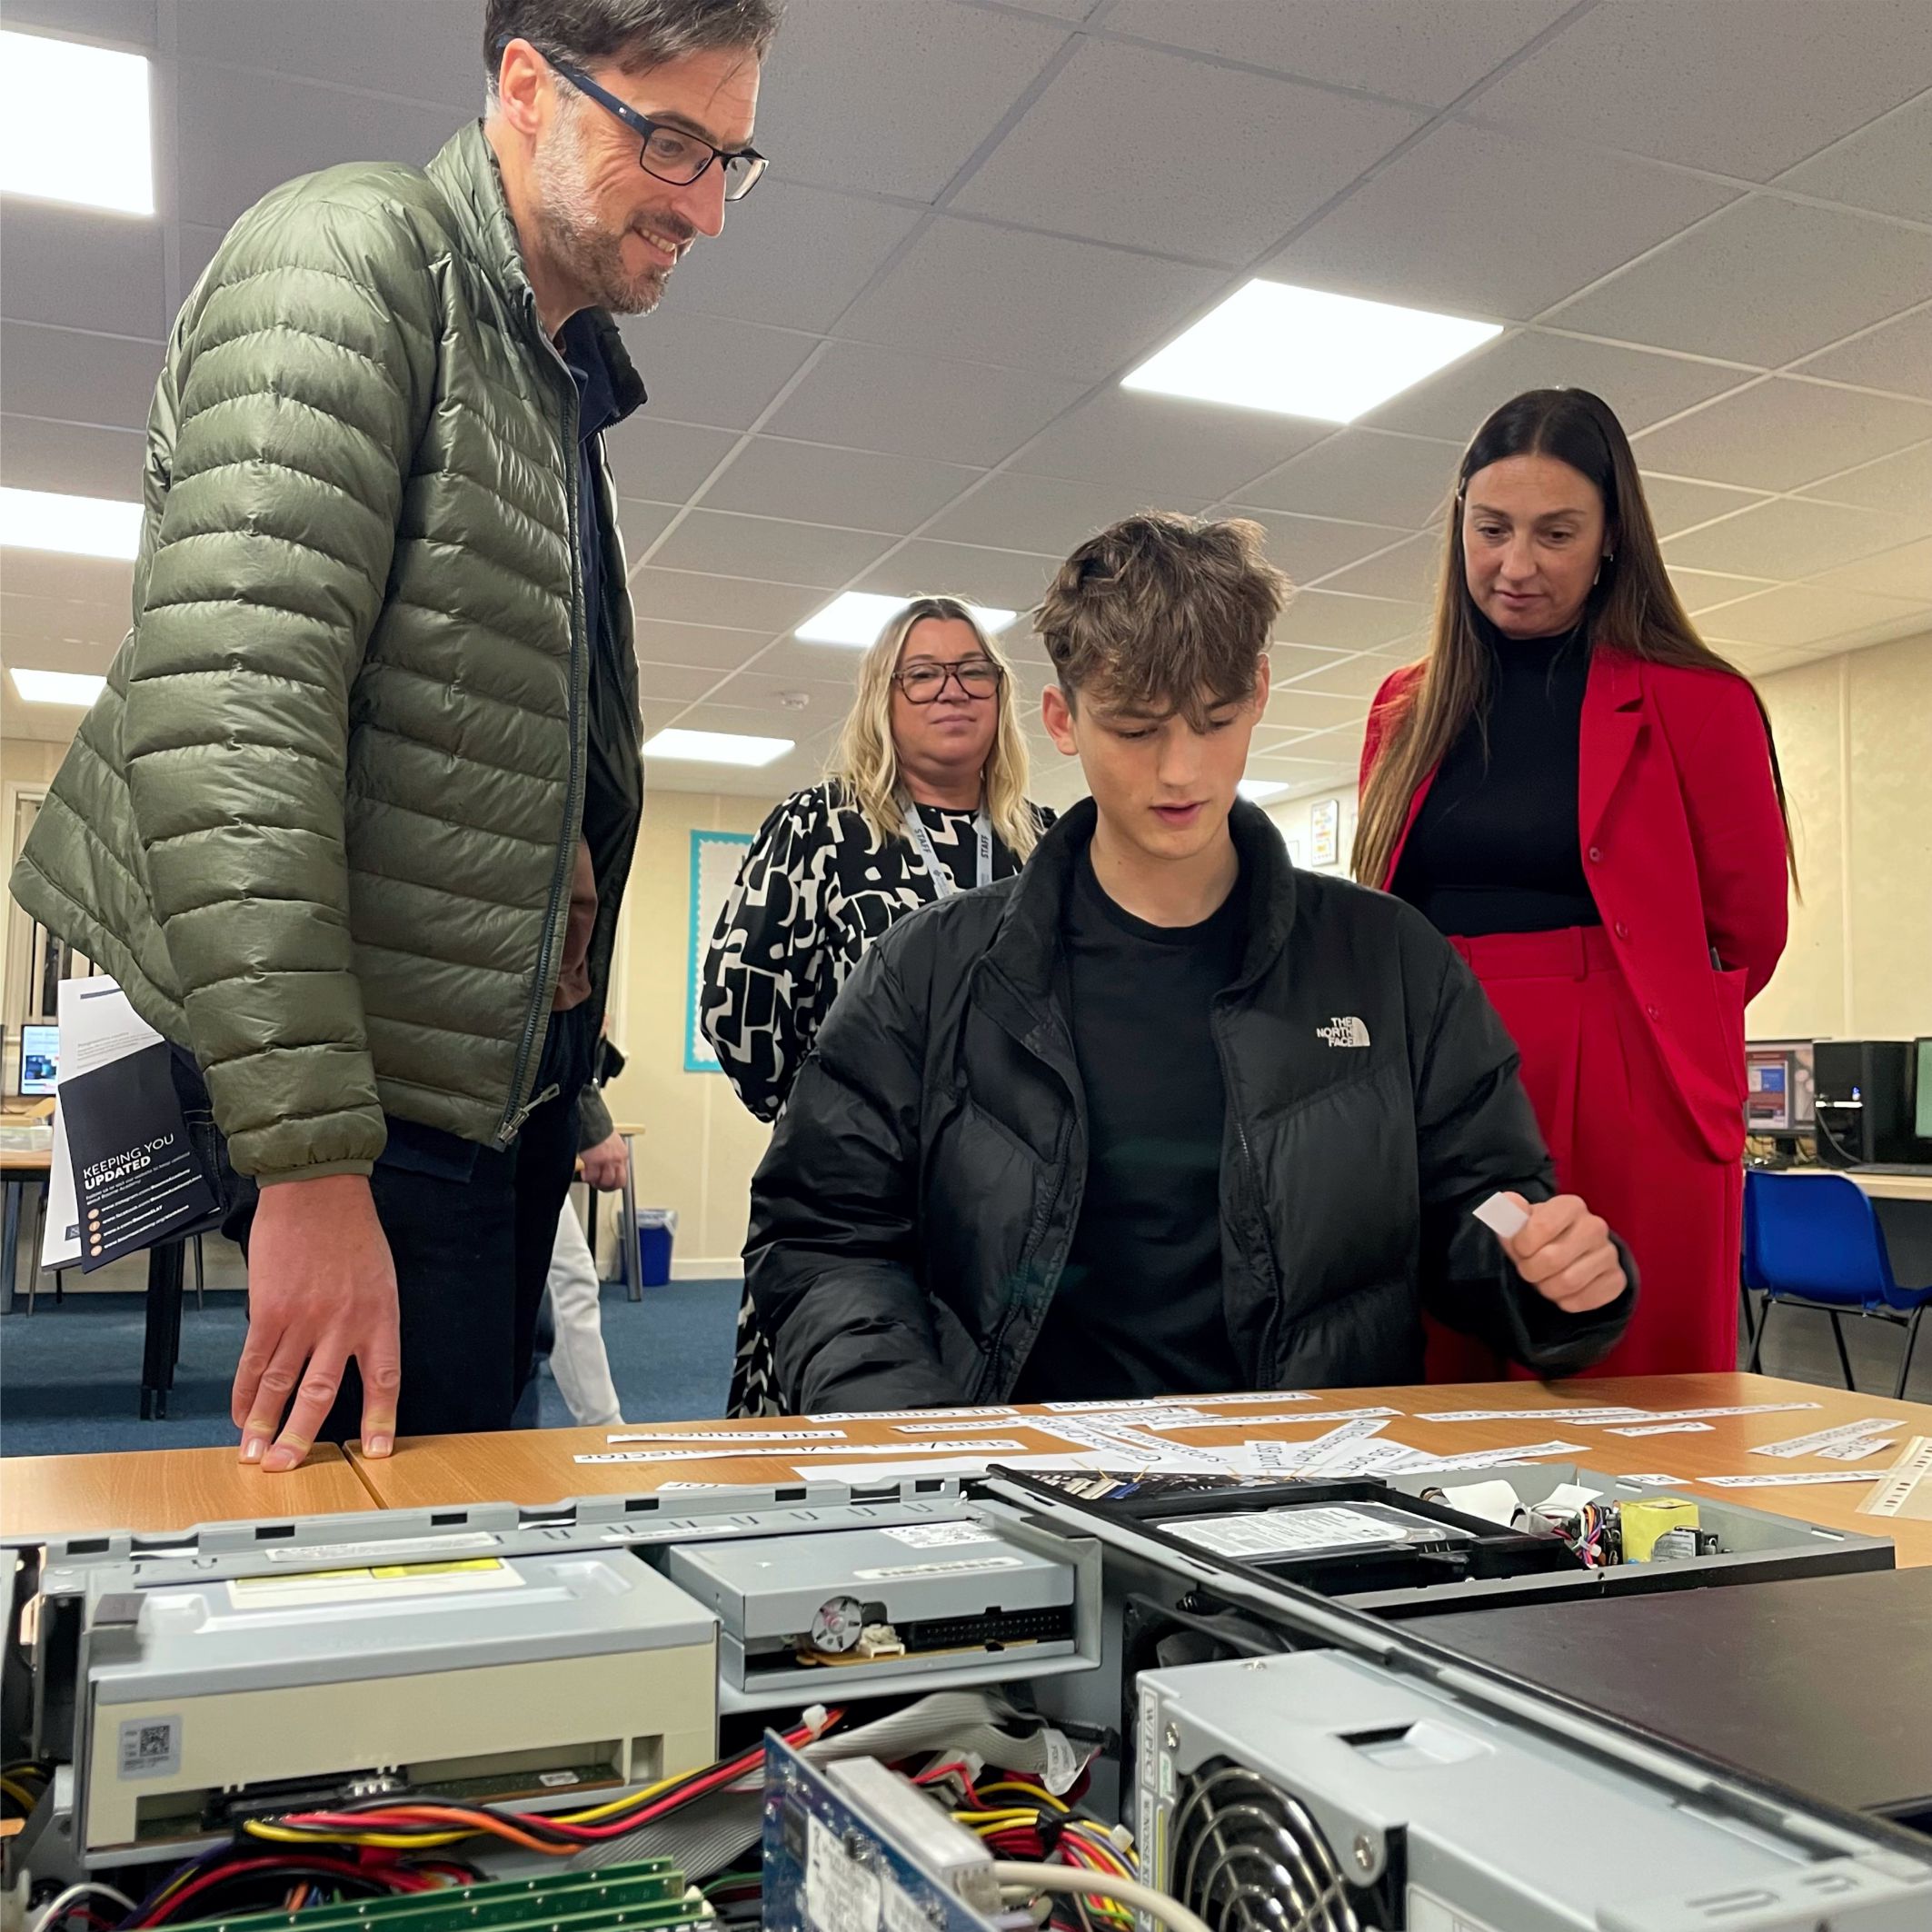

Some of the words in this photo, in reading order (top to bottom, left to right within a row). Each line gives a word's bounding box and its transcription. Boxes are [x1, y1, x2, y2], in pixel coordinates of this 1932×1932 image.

[914, 828, 931, 853] STAFF
[981, 834, 990, 859] STAFF
[1316, 1027, 1352, 1037] NORTH
[1330, 1017, 1352, 1027] THE
[1329, 1037, 1353, 1047] FACE
[83, 1147, 142, 1179] KEEPING
[144, 1133, 174, 1153] YOU
[85, 1156, 151, 1190] UPDATED
[1708, 1476, 1774, 1485] port
[1145, 1708, 1153, 1776] W/PFC
